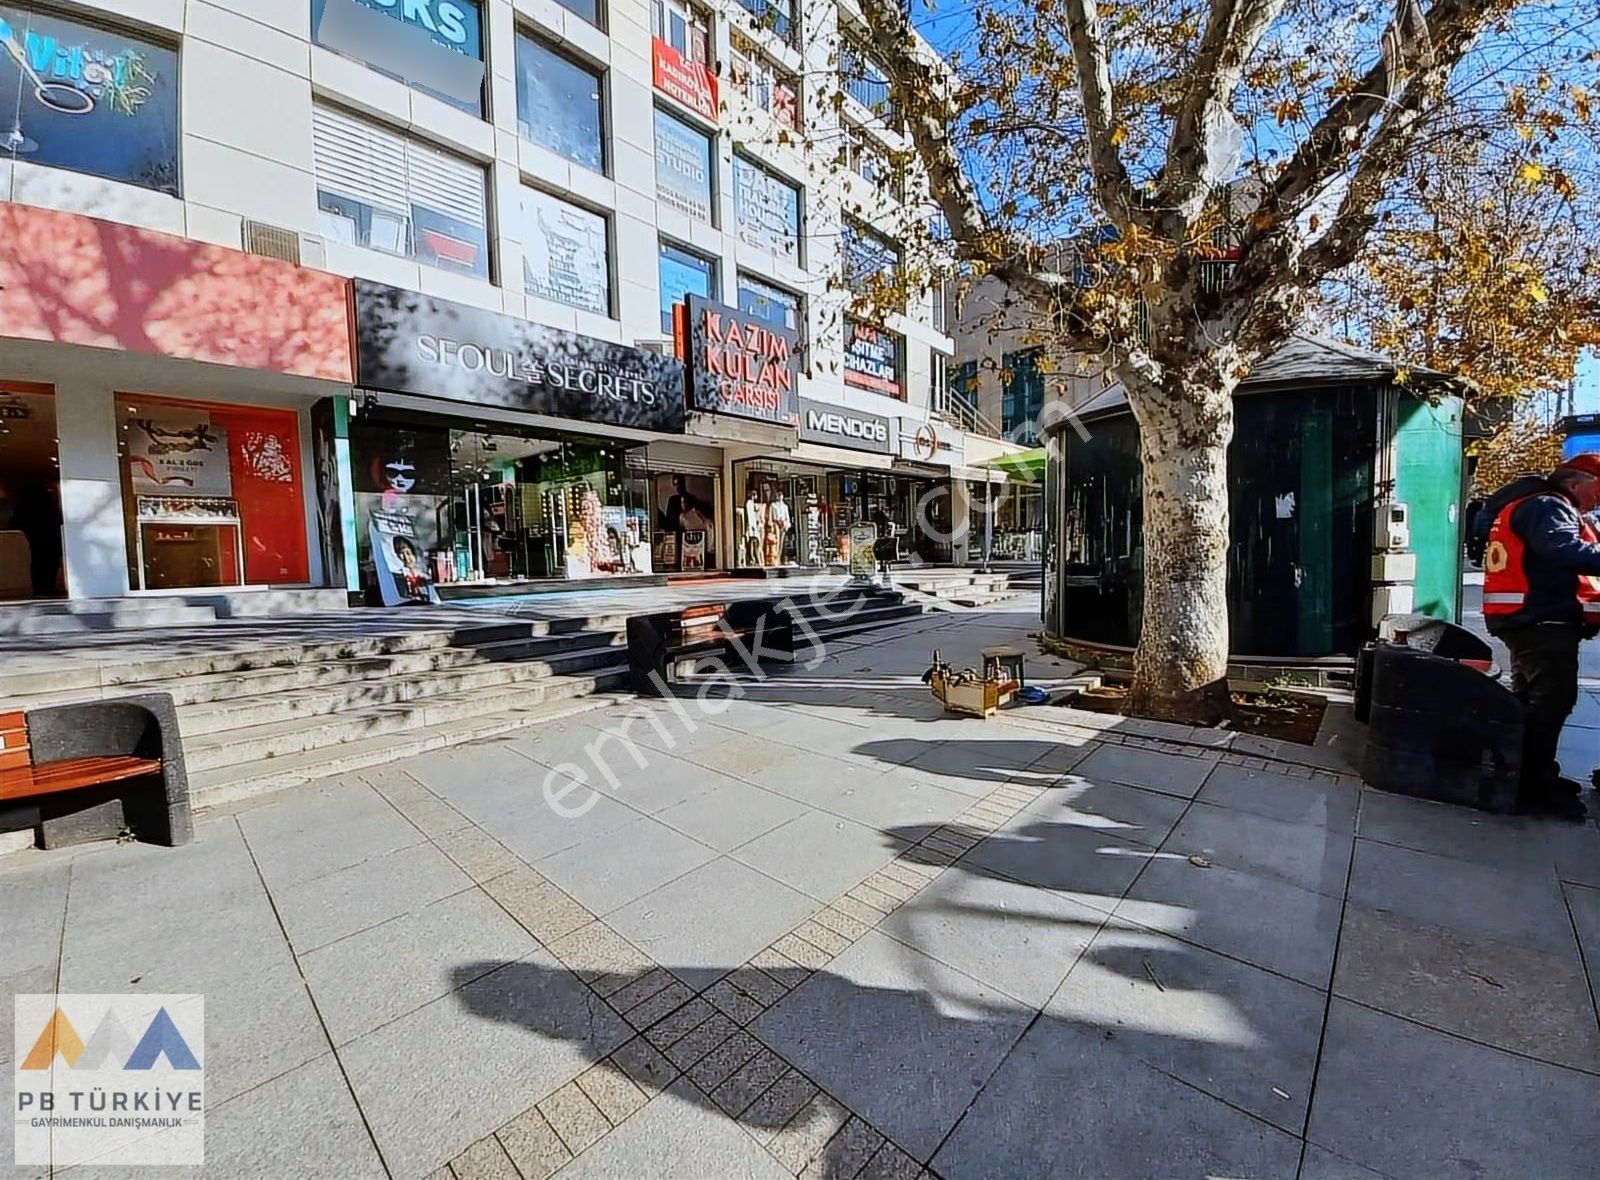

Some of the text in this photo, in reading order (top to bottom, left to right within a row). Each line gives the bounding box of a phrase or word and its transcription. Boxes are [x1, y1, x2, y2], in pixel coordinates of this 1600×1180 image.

[705, 310, 789, 361] KAZIM
[416, 334, 524, 382] SEOUL
[547, 362, 655, 405] SECRETS
[705, 343, 791, 392] KULAN
